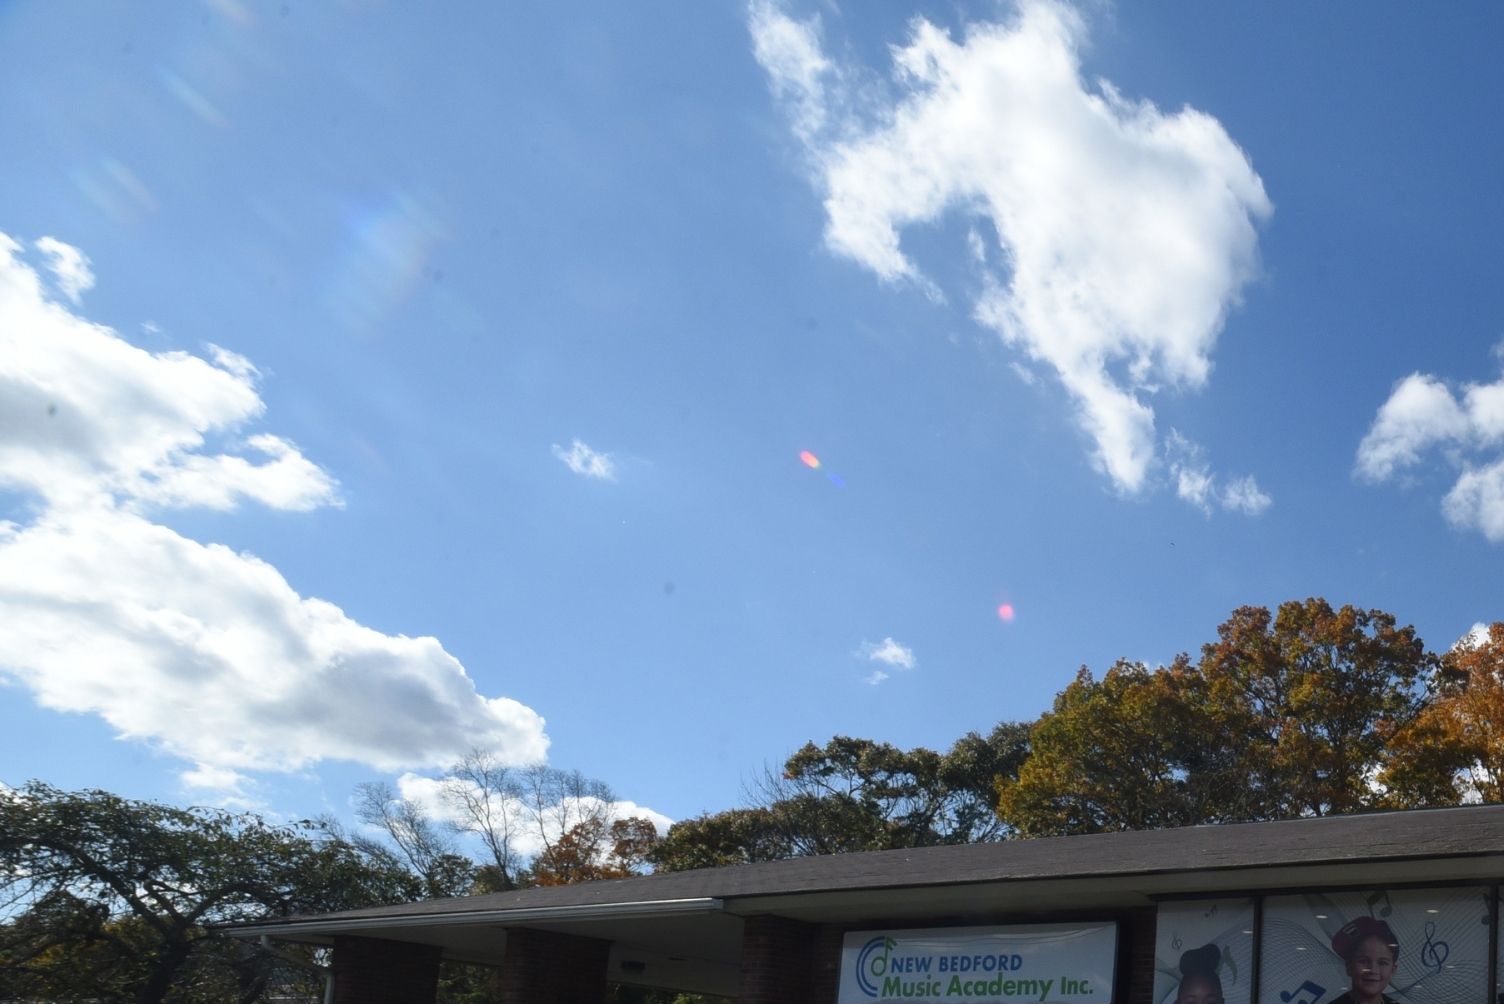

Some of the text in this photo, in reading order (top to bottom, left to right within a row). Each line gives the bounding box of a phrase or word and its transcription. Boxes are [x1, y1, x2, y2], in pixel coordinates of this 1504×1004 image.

[891, 954, 1023, 974] NEW BEDFORD
[881, 972, 1094, 1002] Music Academy Inc.
